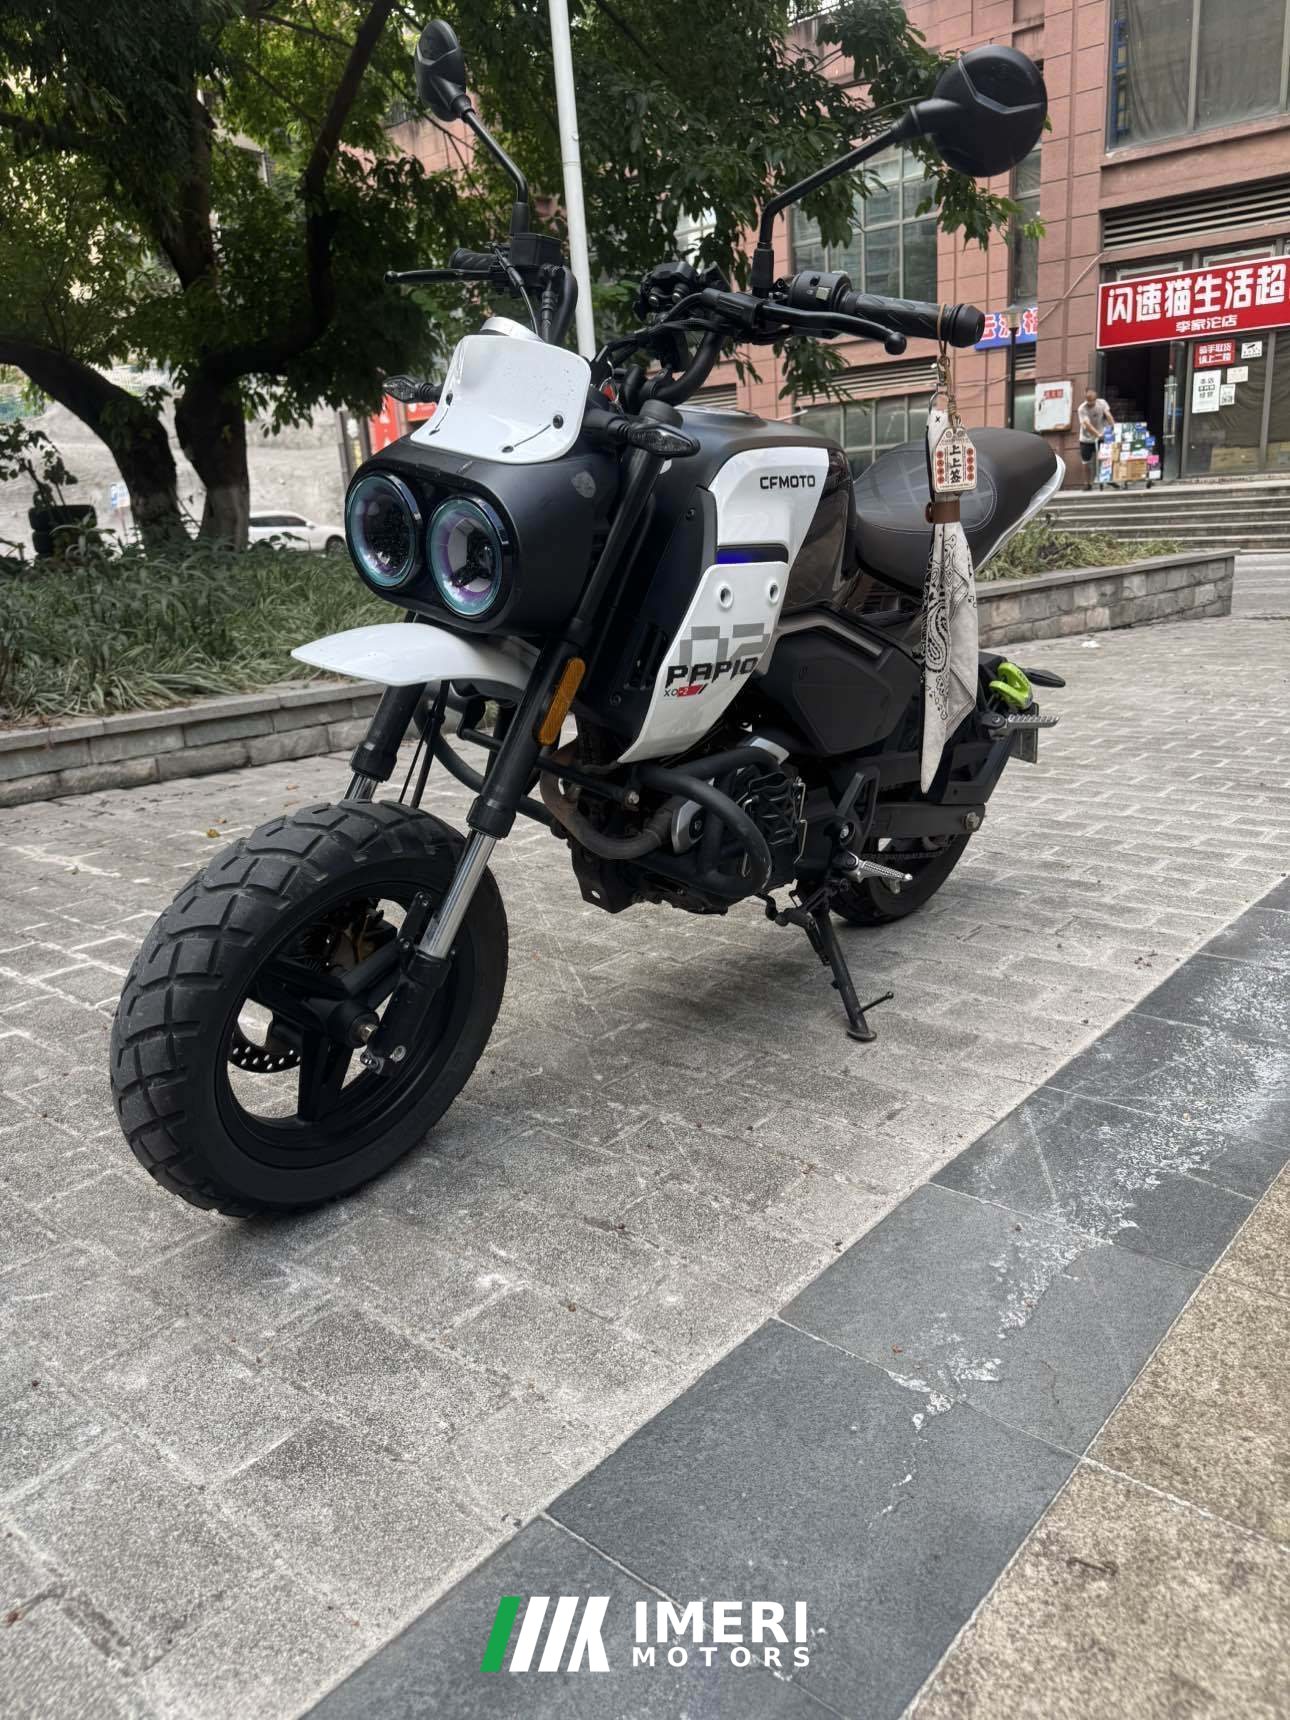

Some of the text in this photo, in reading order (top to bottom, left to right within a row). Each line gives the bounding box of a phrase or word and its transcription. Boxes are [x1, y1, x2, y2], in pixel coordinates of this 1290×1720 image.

[1106, 263, 1290, 326] 闪速猫生活超
[760, 475, 816, 489] CFMOTO
[949, 444, 962, 484] 上上签
[665, 656, 759, 689] PAPIO
